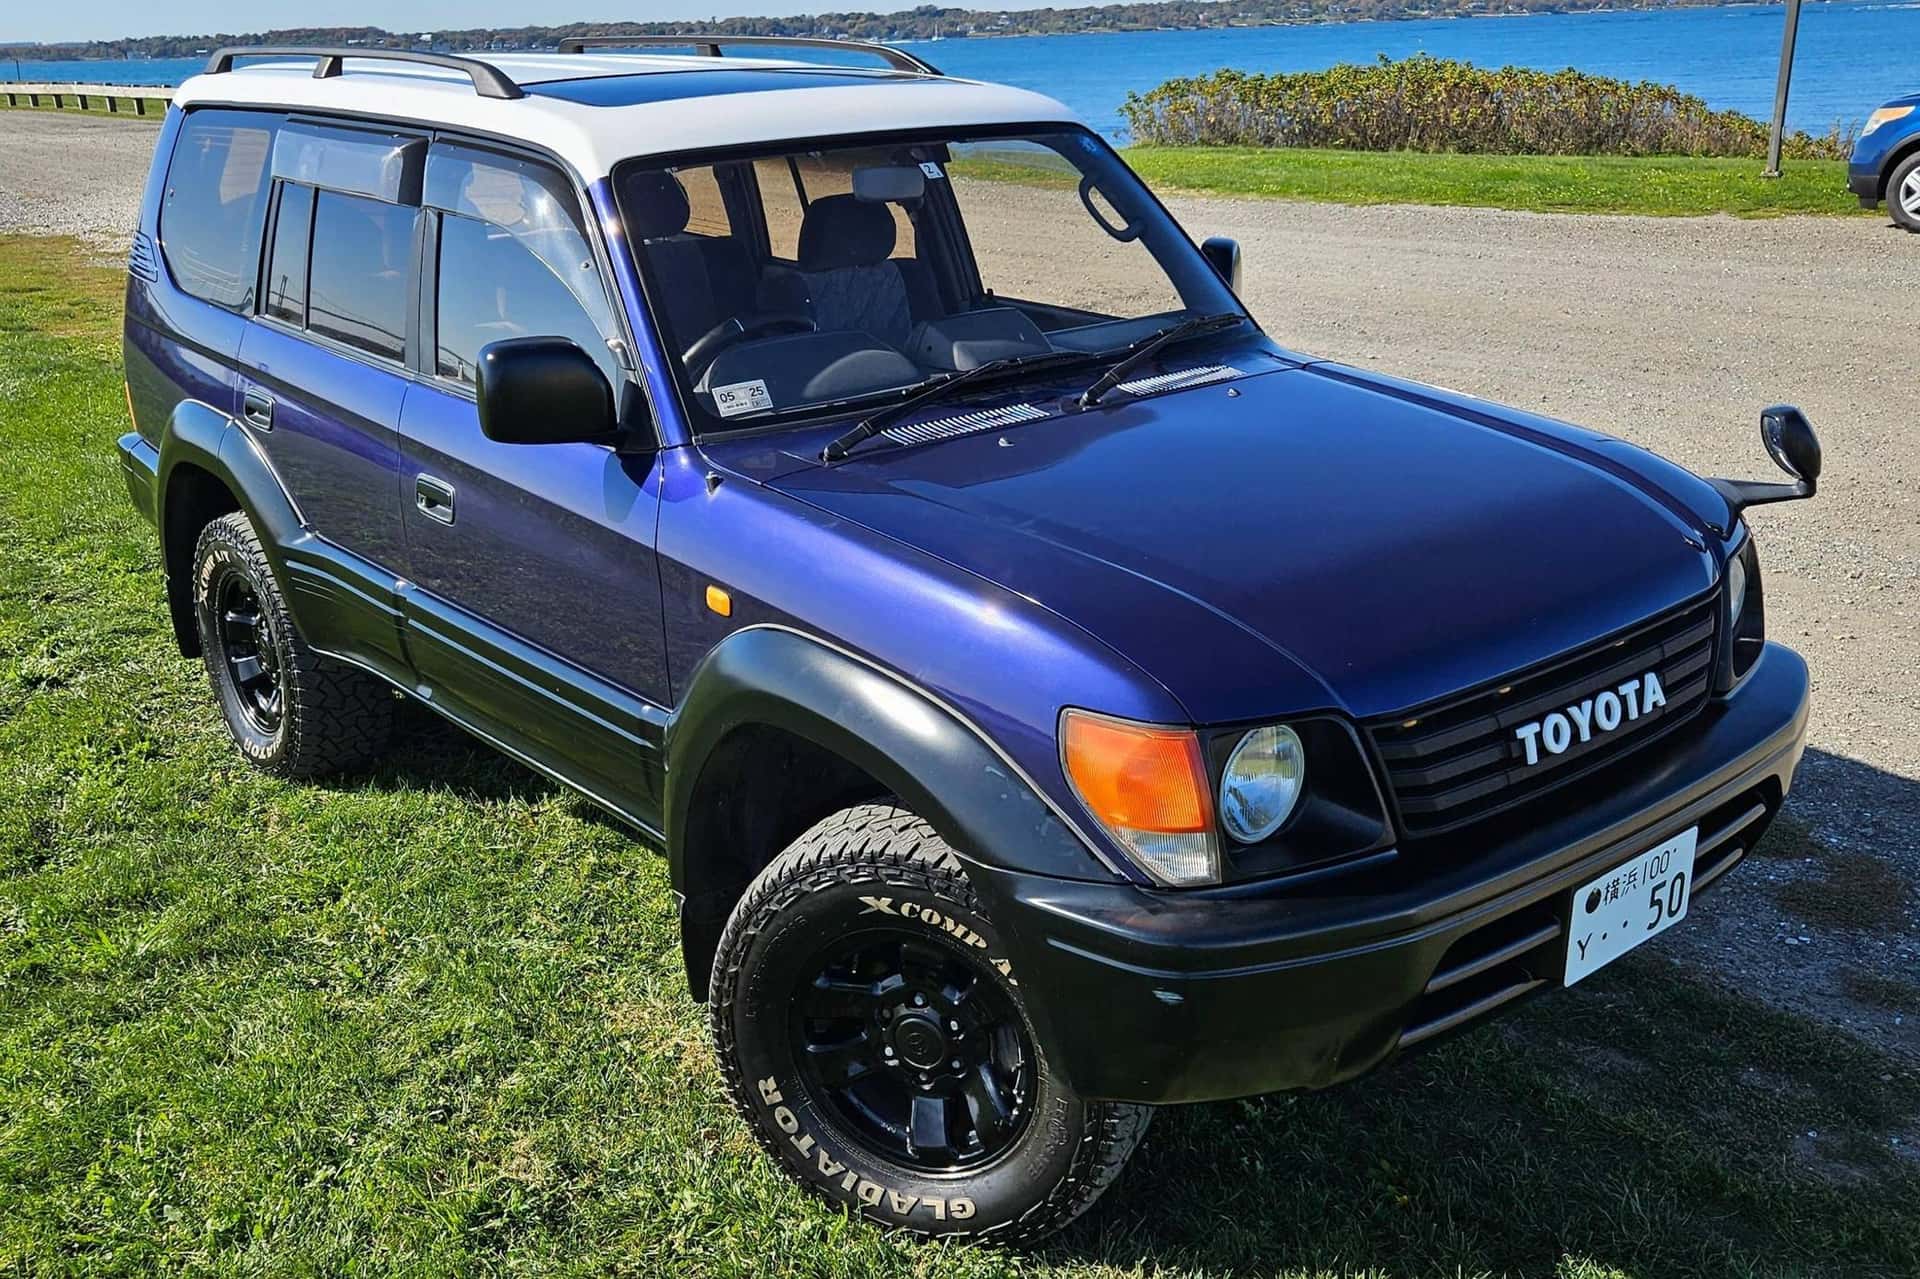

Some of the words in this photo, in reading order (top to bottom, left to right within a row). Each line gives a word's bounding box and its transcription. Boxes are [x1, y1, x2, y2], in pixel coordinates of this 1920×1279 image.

[719, 391, 736, 403] 05
[749, 386, 764, 397] 25
[1515, 672, 1667, 765] TOYOTA
[1576, 932, 1593, 961] Y
[1647, 871, 1686, 930] 50
[1602, 866, 1639, 906] 横浜
[1642, 849, 1671, 885] 100
[758, 1075, 976, 1221] GLADIATOR
